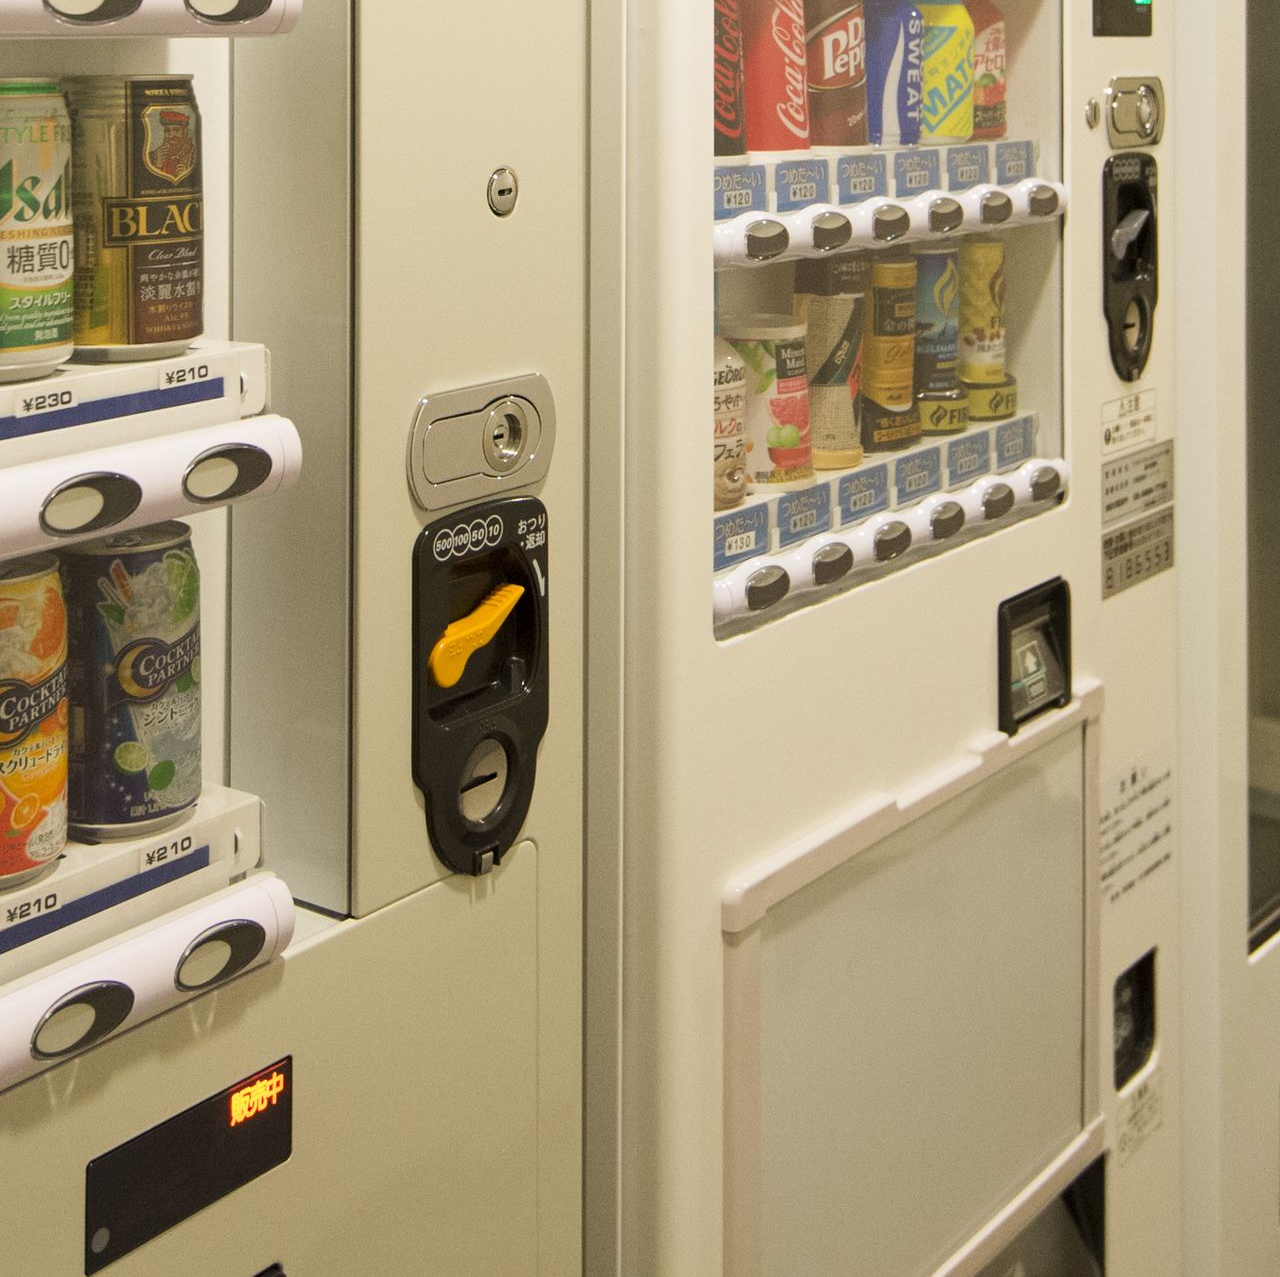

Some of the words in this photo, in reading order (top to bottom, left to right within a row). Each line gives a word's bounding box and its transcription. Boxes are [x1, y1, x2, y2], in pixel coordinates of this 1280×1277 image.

[847, 16, 865, 51] D
[906, 18, 922, 122] SWEAT
[973, 52, 1006, 71] アセロ
[791, 185, 815, 199] ¥120
[852, 178, 874, 192] ¥120
[726, 191, 750, 205] ¥120
[111, 202, 199, 238] BLAC
[6, 239, 70, 275] 糖質0
[165, 364, 209, 386] ¥210
[22, 390, 73, 412] ¥230
[518, 513, 546, 535] おつり
[435, 538, 453, 552] 500
[454, 533, 469, 547] 100
[471, 528, 485, 542] 50
[488, 523, 500, 537] 10
[727, 535, 751, 551] ¥130
[145, 835, 193, 866] ¥210
[6, 893, 58, 923] ¥210
[228, 1071, 285, 1127] 販売中
